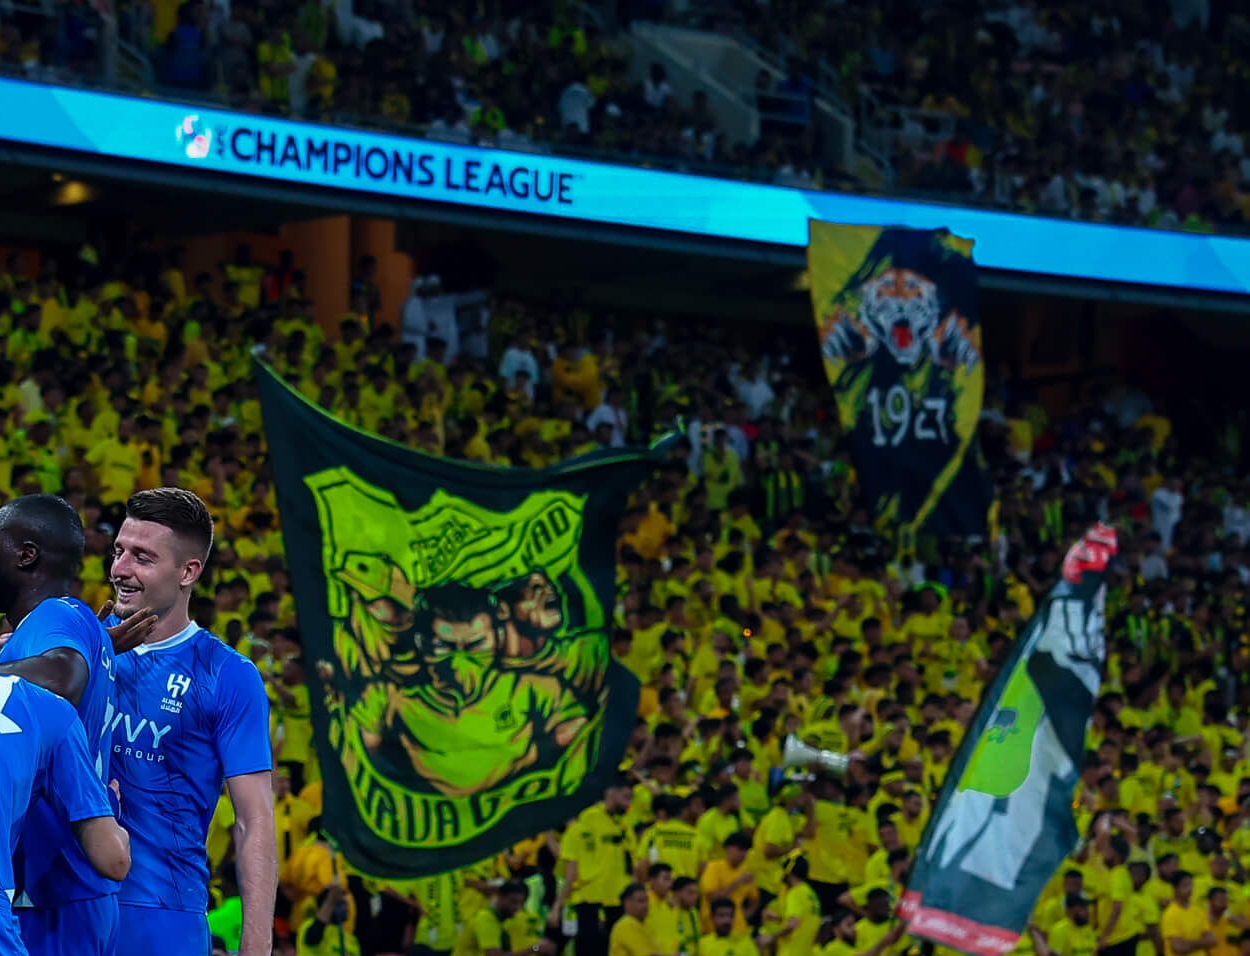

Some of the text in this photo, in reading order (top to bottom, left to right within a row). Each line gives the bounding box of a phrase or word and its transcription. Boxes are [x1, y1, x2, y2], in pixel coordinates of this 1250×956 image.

[230, 126, 435, 187] CHAMPIONS
[445, 162, 573, 204] LEAGUE
[113, 744, 165, 763] GROUP
